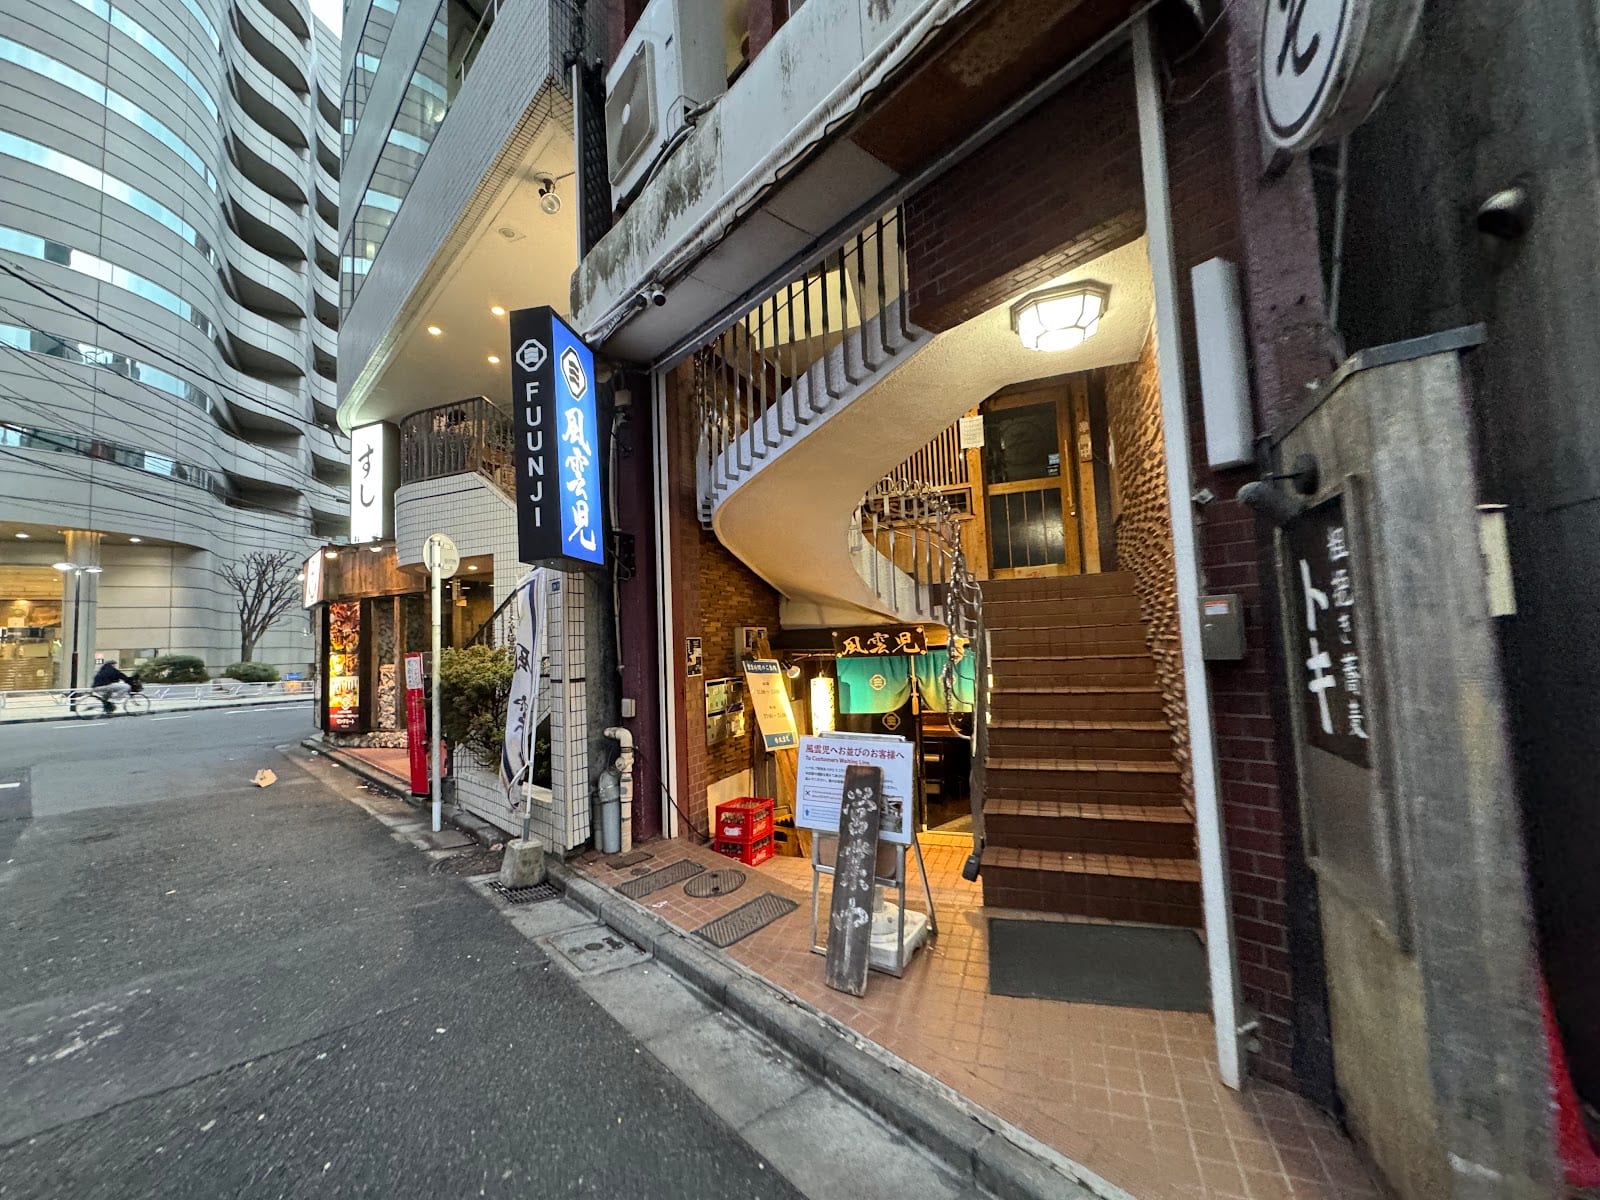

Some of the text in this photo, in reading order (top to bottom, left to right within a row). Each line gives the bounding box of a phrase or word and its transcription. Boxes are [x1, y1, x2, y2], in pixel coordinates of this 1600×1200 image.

[358, 443, 375, 508] すし
[525, 381, 545, 527] FUUNJI
[562, 406, 597, 552] 風雲児
[841, 631, 921, 656] 風雲児
[1299, 558, 1336, 735] トキ
[805, 743, 905, 760] 風雲児へお並びのお客様へ
[839, 757, 858, 765] Waiting
